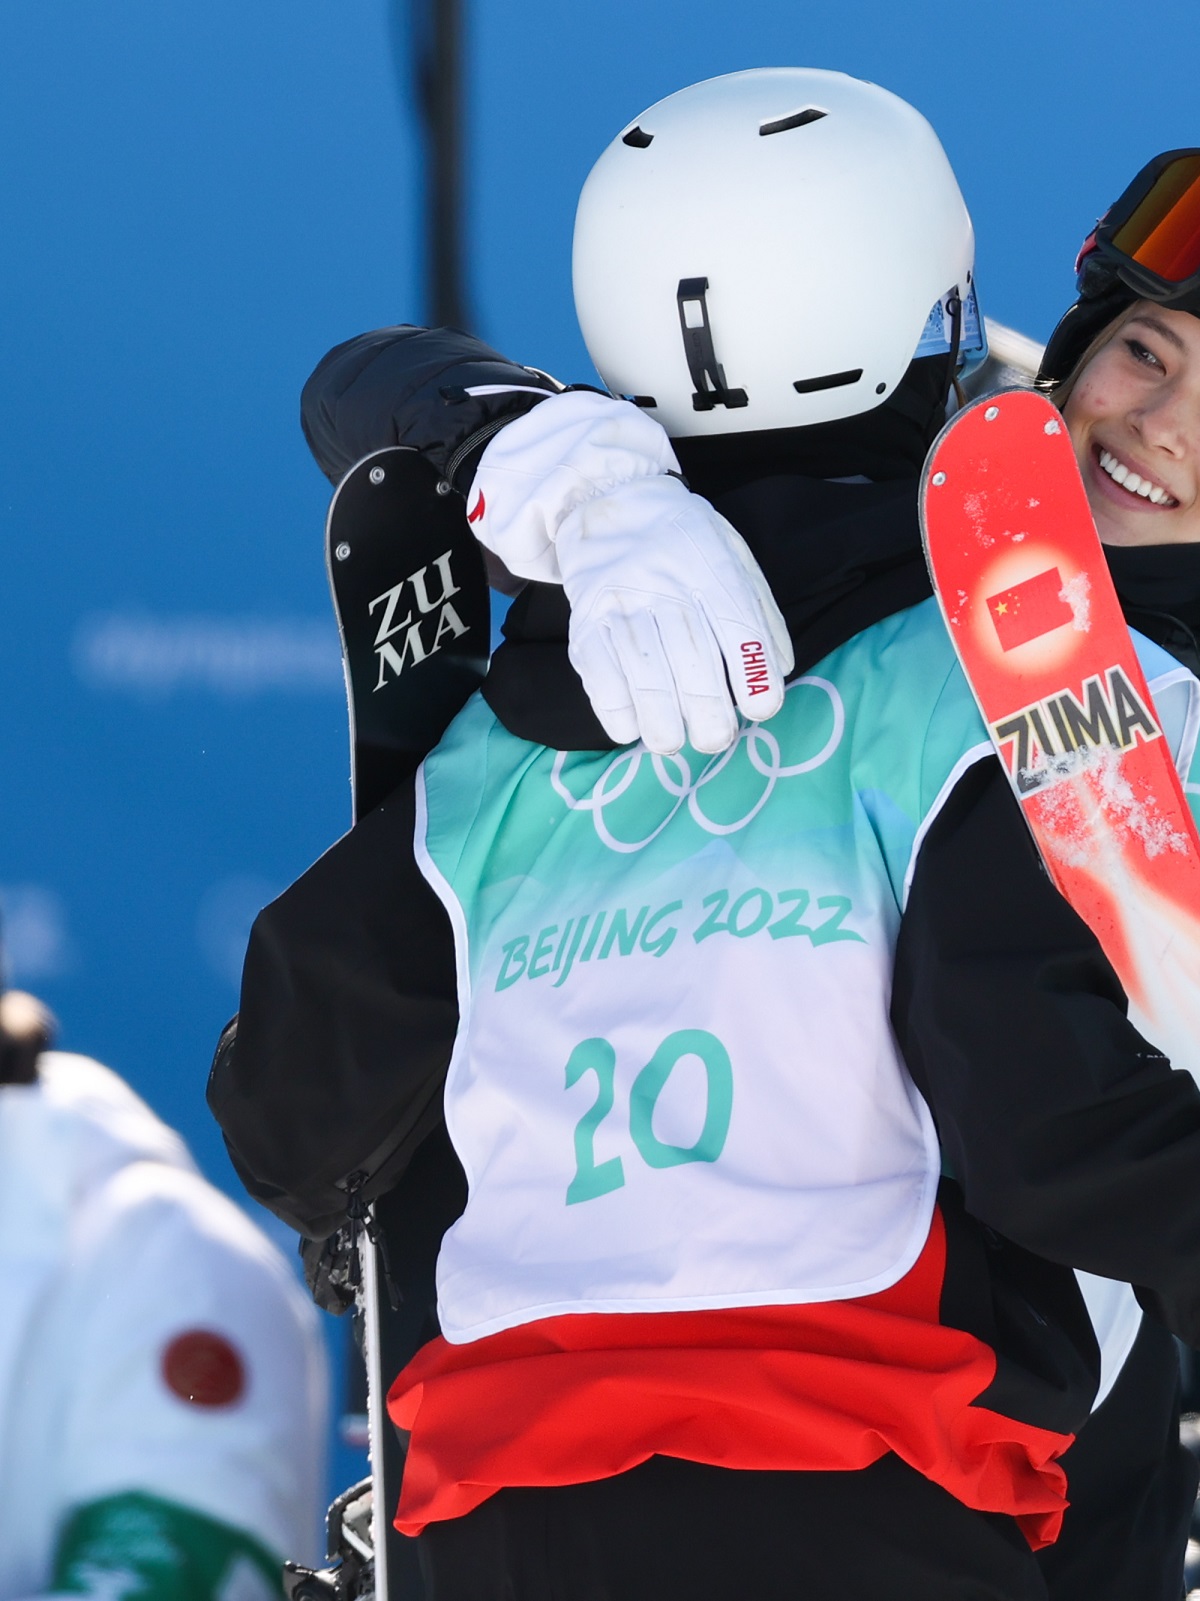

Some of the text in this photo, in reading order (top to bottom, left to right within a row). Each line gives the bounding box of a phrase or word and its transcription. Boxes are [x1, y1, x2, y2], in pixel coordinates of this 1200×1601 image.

[368, 549, 461, 647] ZU
[372, 601, 471, 693] MA
[740, 641, 769, 696] CHINA
[992, 666, 1160, 797] ZUMA
[494, 887, 870, 992] BEIJING 2022
[564, 1028, 733, 1207] 20
